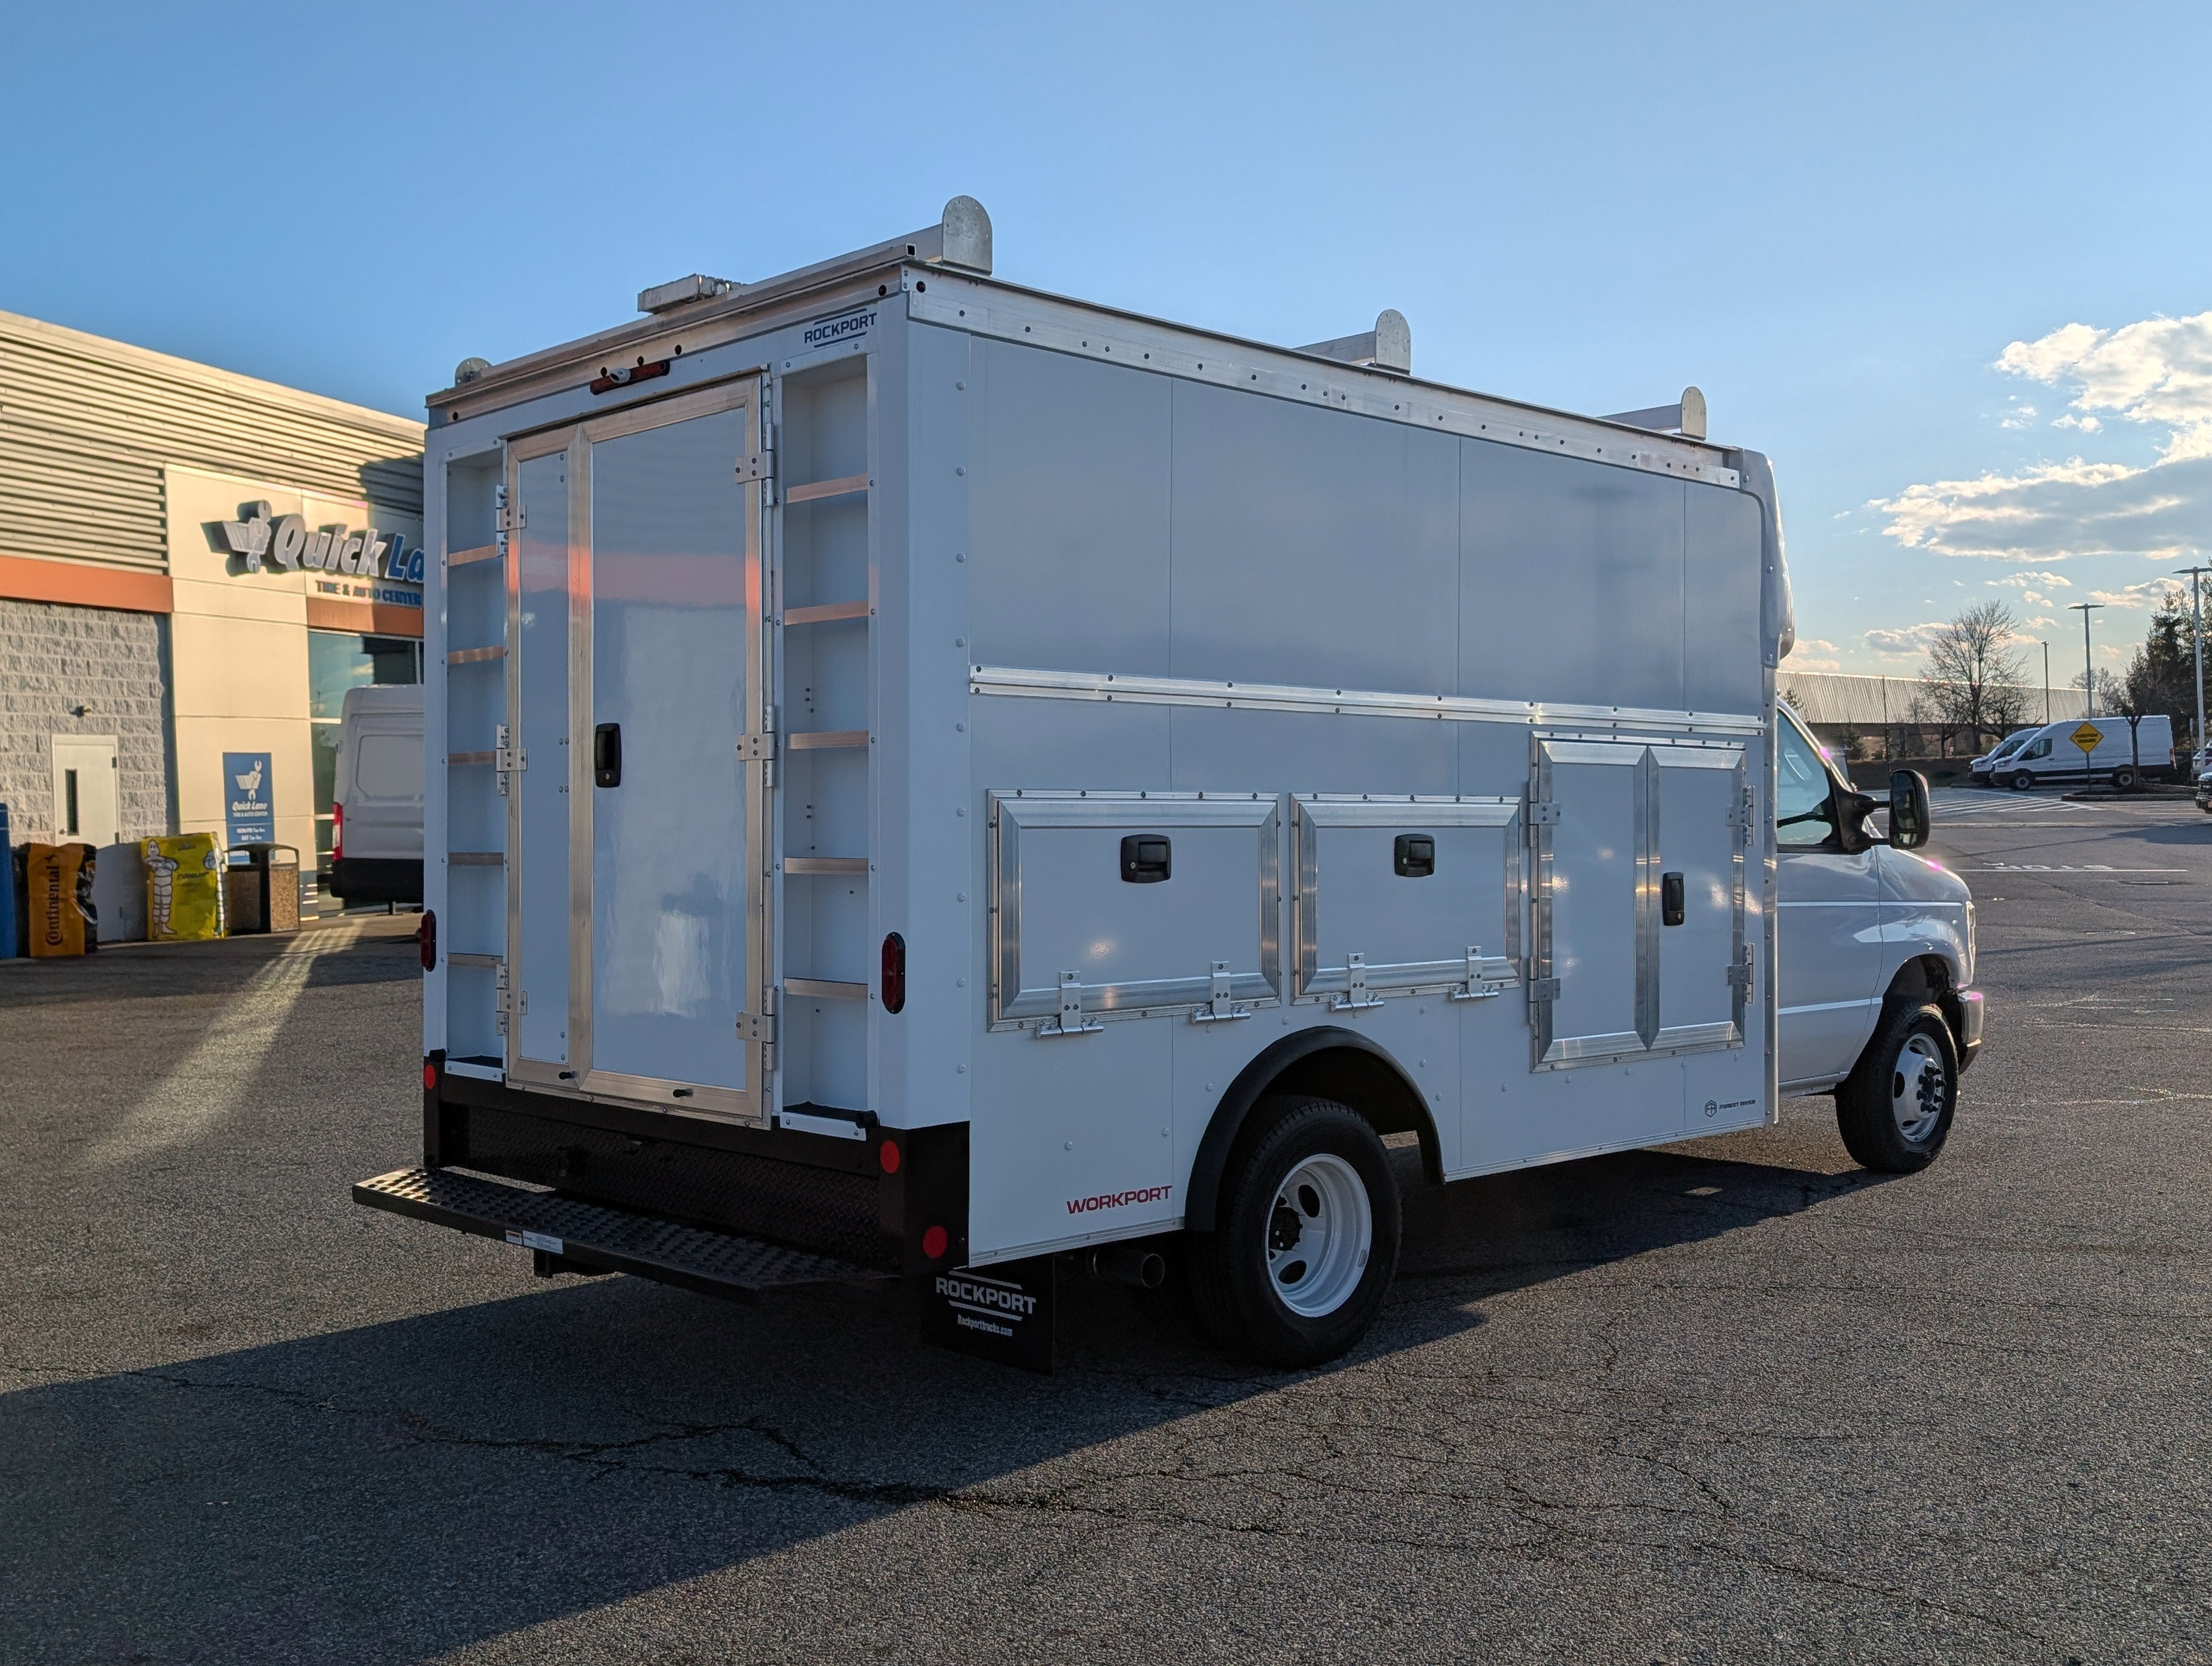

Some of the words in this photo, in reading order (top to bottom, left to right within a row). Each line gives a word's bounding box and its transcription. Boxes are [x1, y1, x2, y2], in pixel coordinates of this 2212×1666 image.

[804, 312, 878, 344] ROCKPORT
[274, 514, 388, 578] Quick
[315, 580, 340, 594] TIRE
[342, 584, 350, 596] &
[352, 585, 382, 600] AUTO
[382, 588, 422, 606] CENTER
[232, 800, 250, 811] Quick
[252, 801, 268, 810] Lane
[45, 864, 63, 946] Continental
[1066, 1185, 1173, 1215] WORKPORT
[935, 1276, 1037, 1315] ROCKPORT
